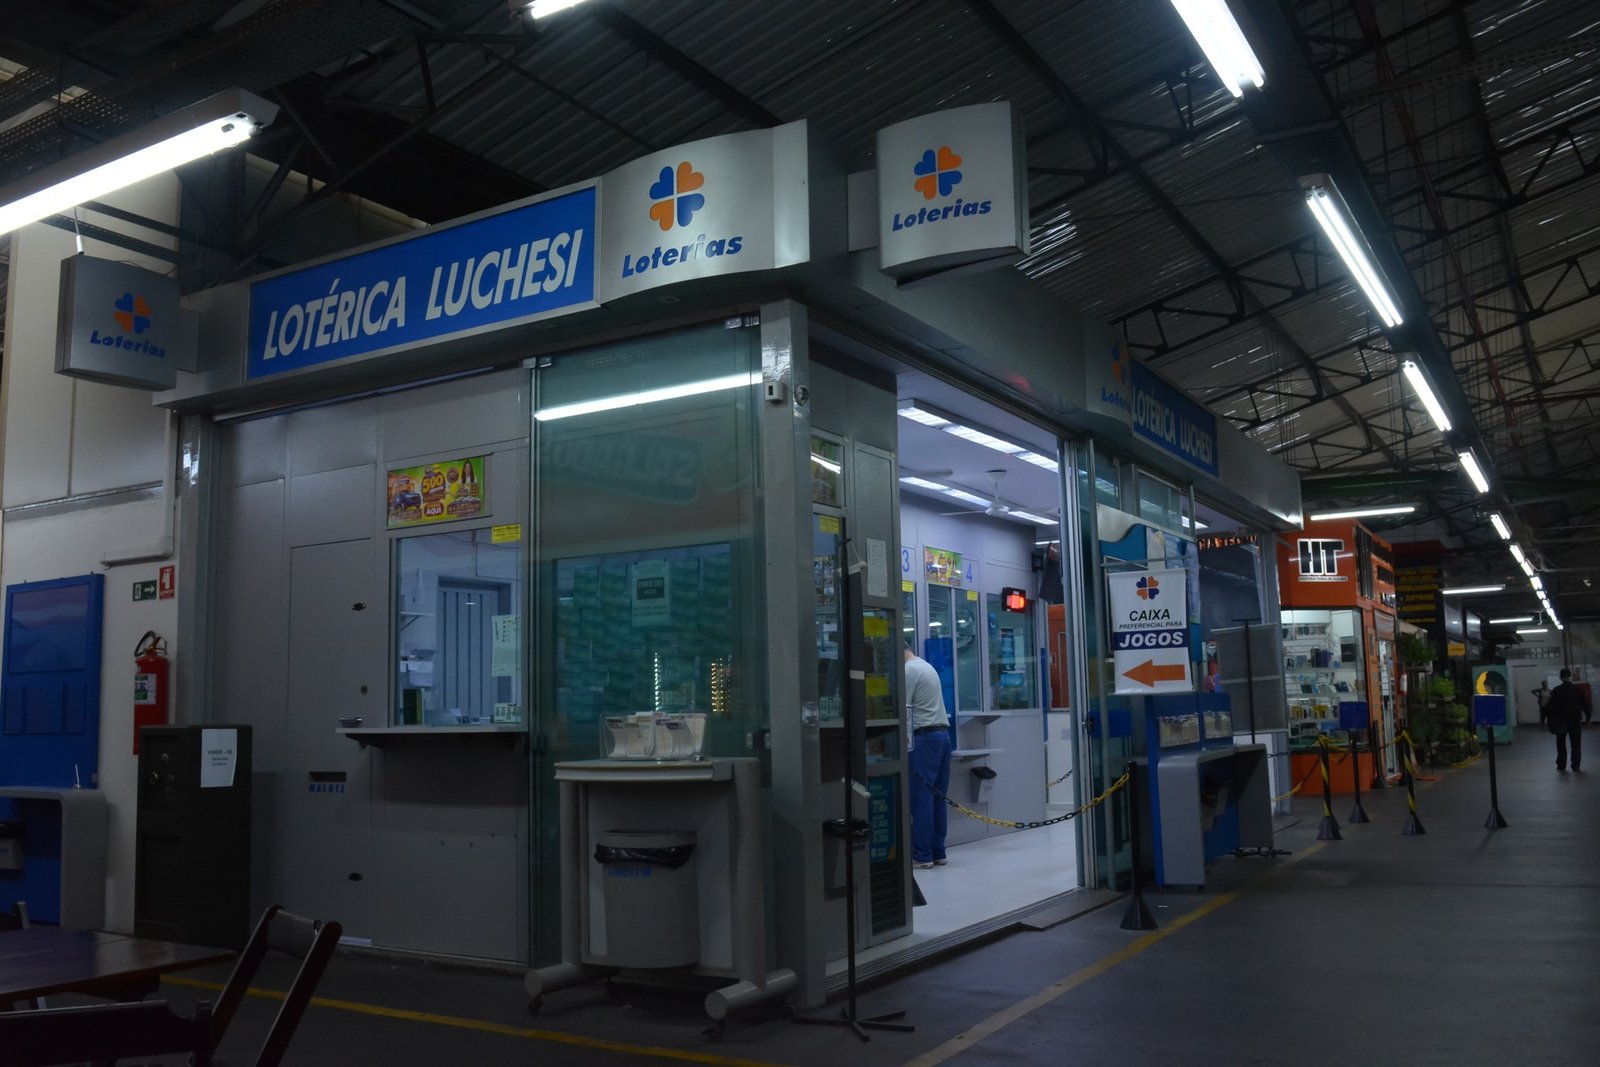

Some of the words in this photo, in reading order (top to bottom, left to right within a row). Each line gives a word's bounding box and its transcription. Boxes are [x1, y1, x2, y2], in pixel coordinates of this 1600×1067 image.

[892, 199, 992, 232] Loterias
[622, 233, 743, 279] Loterias
[262, 277, 407, 360] LOTÉRICA
[425, 228, 584, 321] LUCHESI
[90, 330, 167, 358] Loterias
[1180, 416, 1213, 466] LUCHESI
[422, 474, 444, 493] 500
[902, 550, 910, 573] 3
[965, 560, 973, 583] 4
[1119, 622, 1164, 630] PREFERENCIAL
[1129, 608, 1170, 621] CAIXA
[1119, 631, 1183, 648] JOGOS
[308, 783, 345, 793] MALOTE
